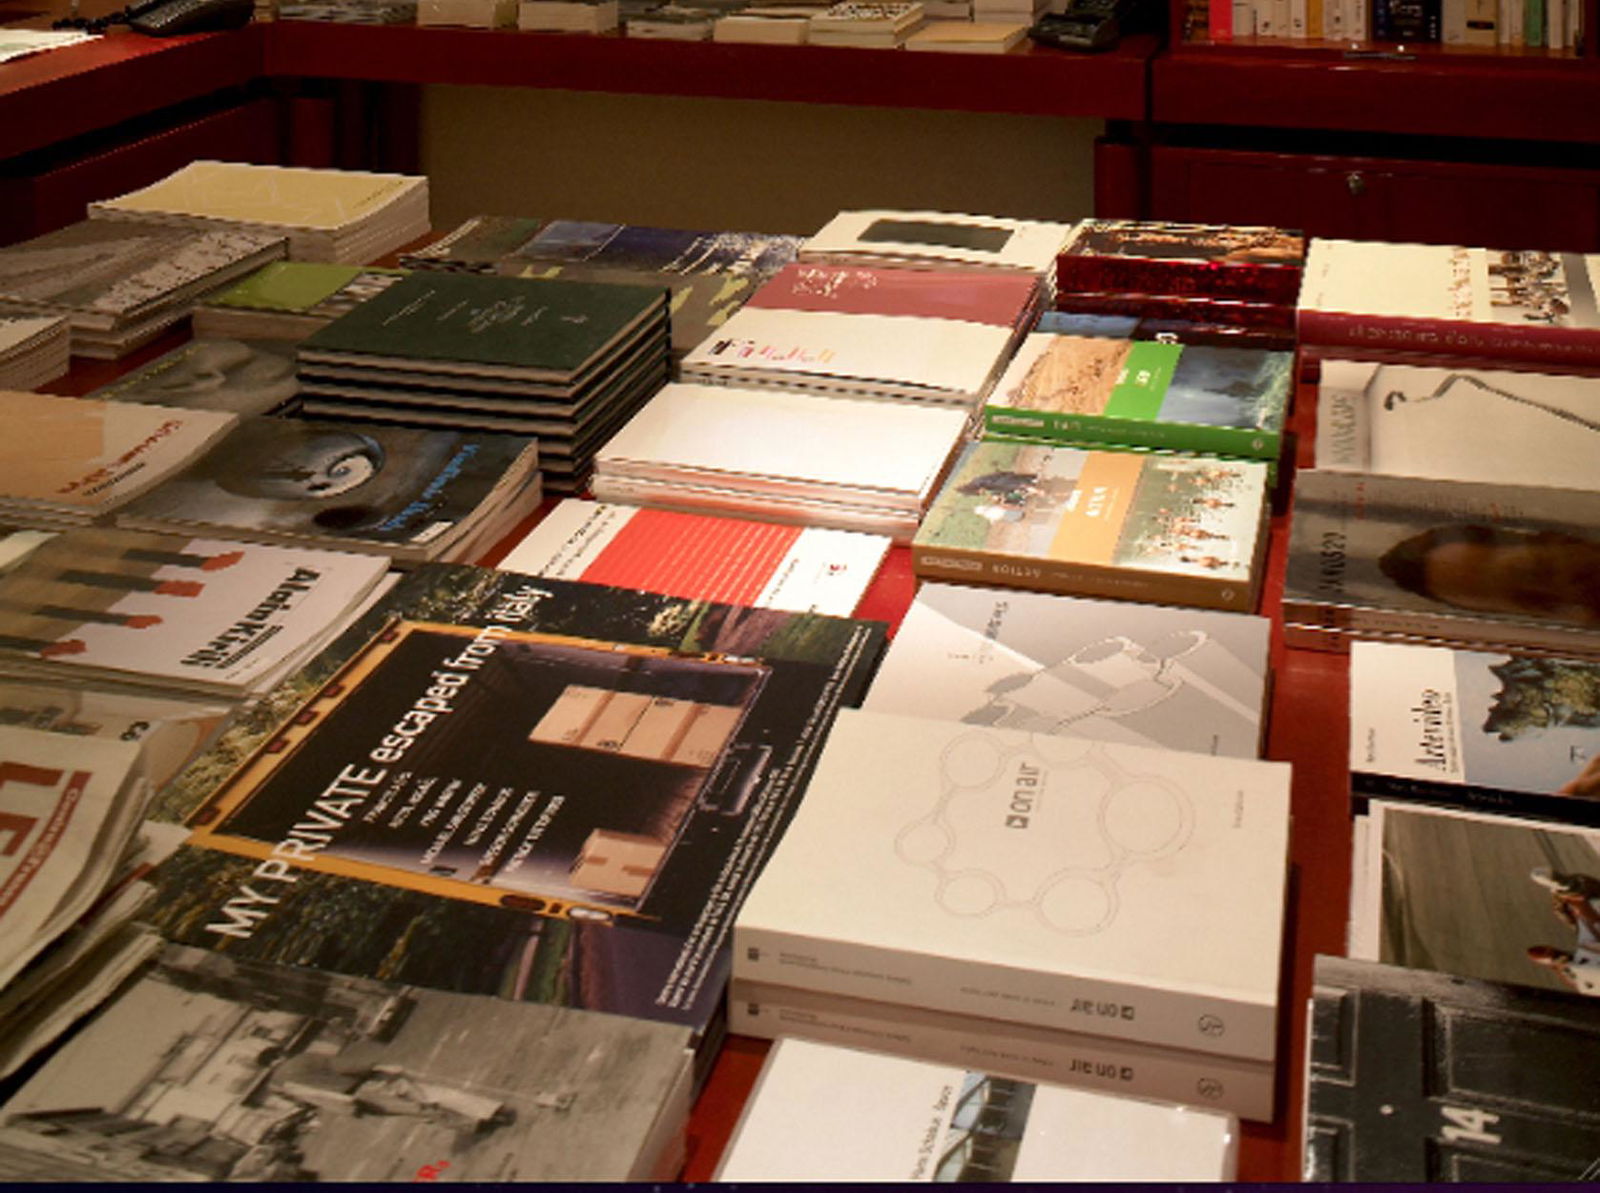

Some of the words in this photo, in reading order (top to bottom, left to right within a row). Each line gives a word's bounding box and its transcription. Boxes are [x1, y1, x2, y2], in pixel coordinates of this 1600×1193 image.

[205, 886, 280, 939] MY
[254, 764, 388, 883] PRIVATE
[370, 670, 471, 763] escaped
[443, 624, 513, 673] from
[488, 585, 553, 624] italy
[1015, 762, 1040, 790] air
[1010, 790, 1031, 814] on
[1441, 1106, 1501, 1144] 14
